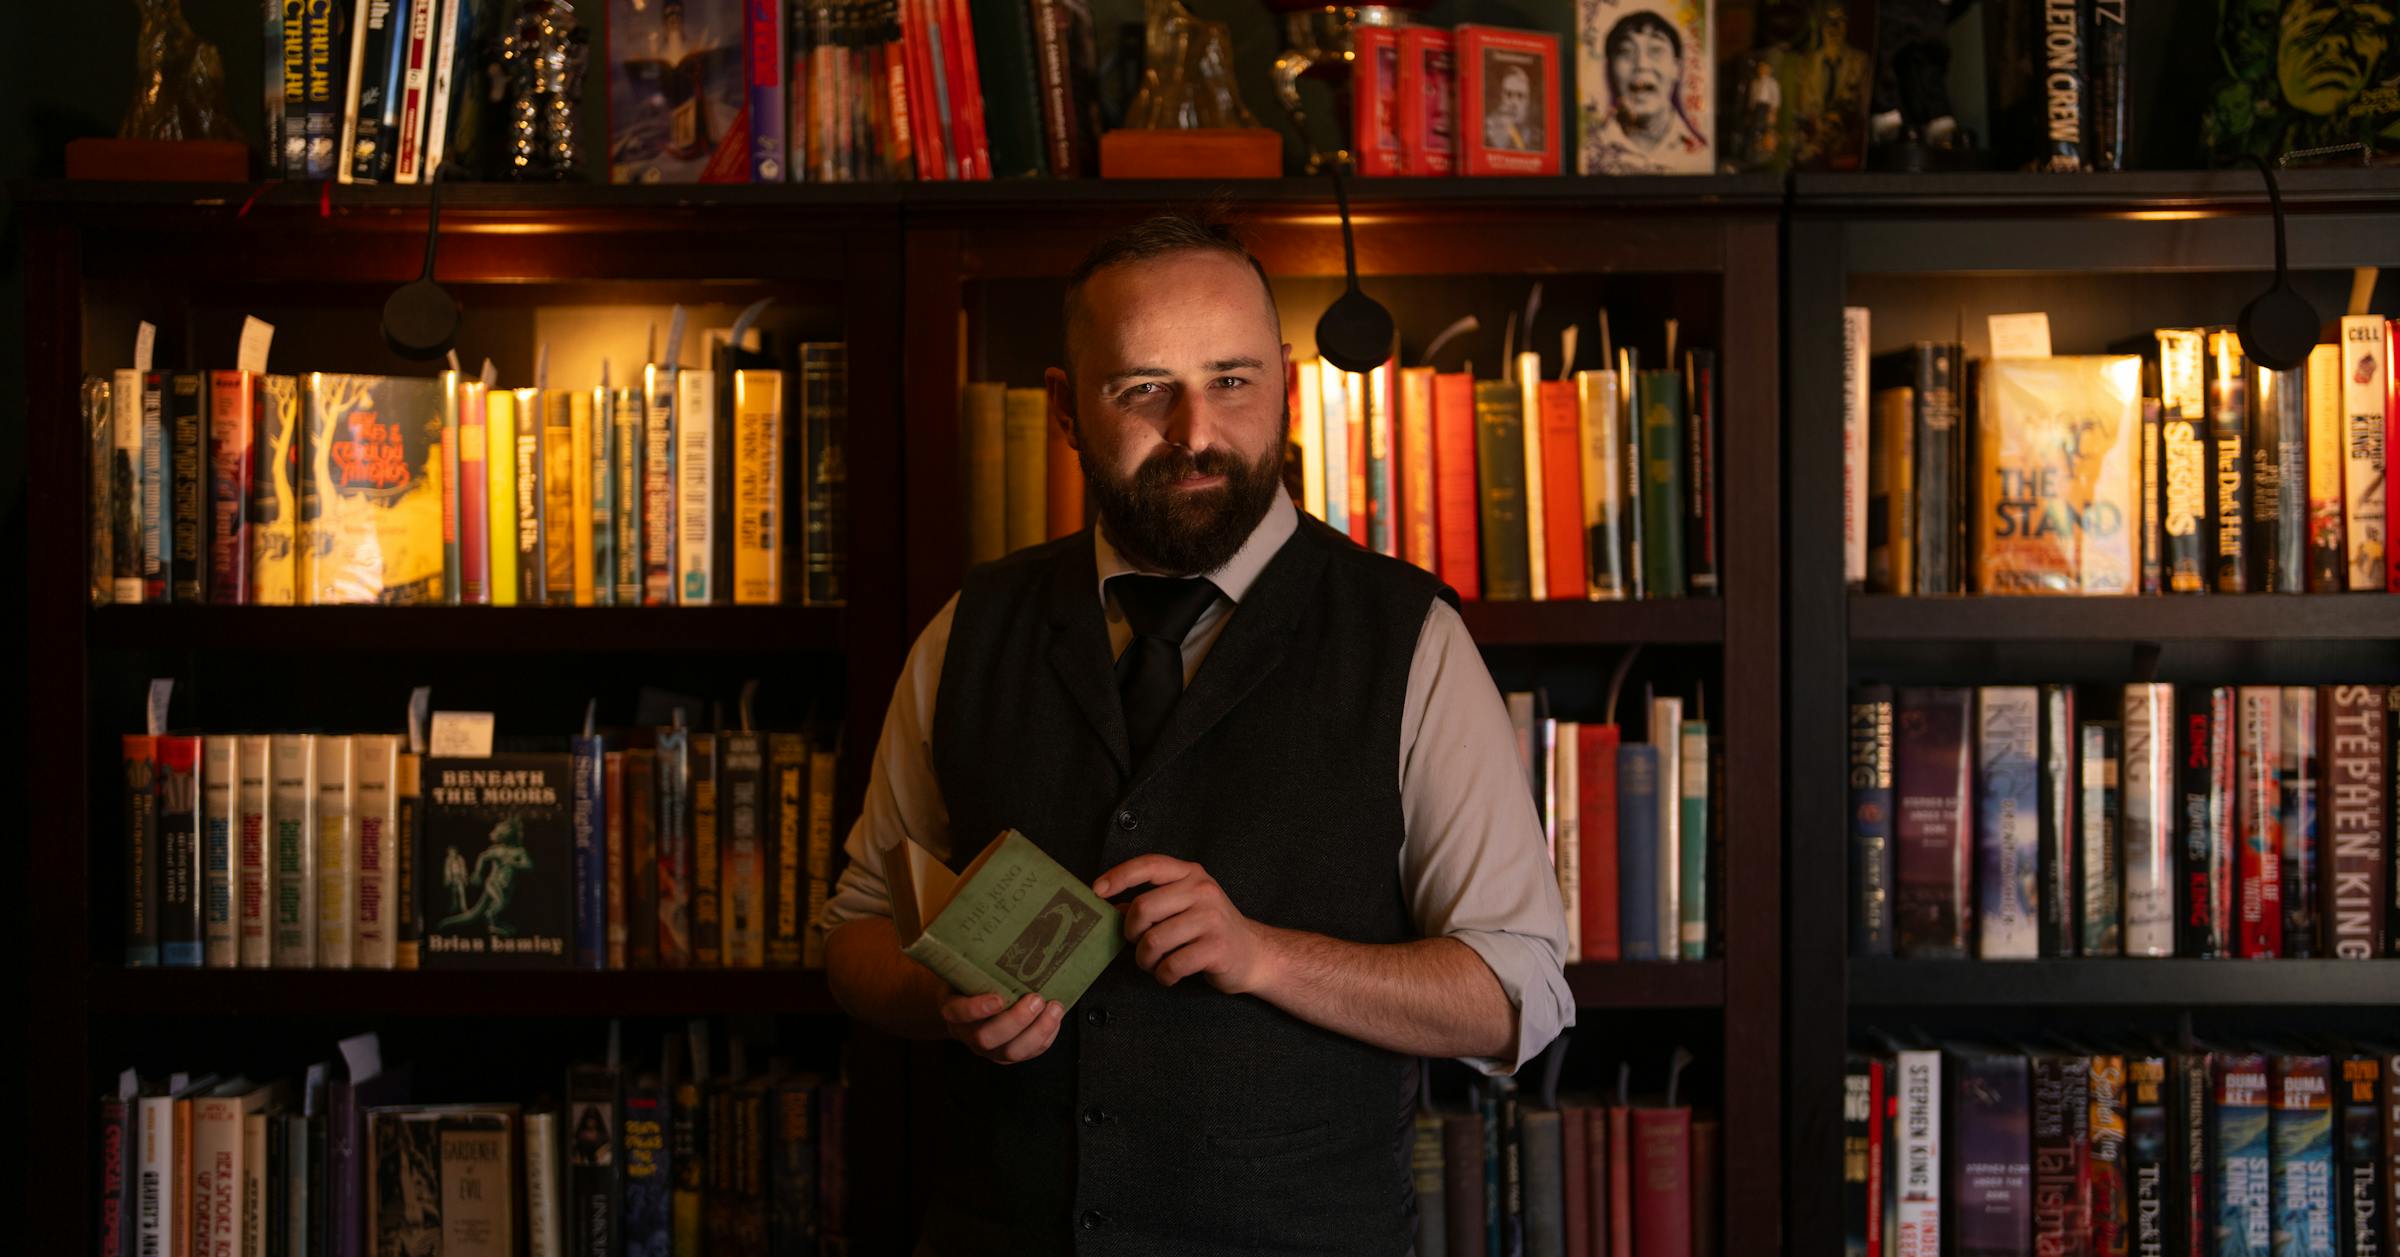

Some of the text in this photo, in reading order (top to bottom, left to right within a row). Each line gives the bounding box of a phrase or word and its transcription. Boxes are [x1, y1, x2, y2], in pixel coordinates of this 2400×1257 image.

[2046, 73, 2079, 143] CREW
[2349, 328, 2381, 341] CELL
[176, 415, 198, 442] WHO
[2350, 414, 2369, 460] KING
[1996, 466, 2059, 498] THE
[2163, 420, 2197, 537] SEASONS
[2218, 433, 2241, 558] The Dark Half
[517, 518, 538, 553] File
[1995, 501, 2122, 540] STAND
[1849, 702, 1877, 789] KING
[1877, 701, 1894, 790] STEPHEN
[1985, 702, 2016, 800] KING
[2126, 694, 2151, 783] KING
[2189, 713, 2208, 769] KING
[431, 785, 557, 806] THE MOORS
[440, 769, 546, 787] BENEATH
[209, 817, 228, 871] Selected
[243, 812, 263, 867] Selected
[360, 816, 382, 871] Selected
[2335, 684, 2372, 960] STEPHEN KING
[243, 871, 263, 918] Letters
[279, 819, 301, 925] Selected Letters
[2262, 853, 2279, 903] END OF
[209, 876, 228, 924] Letters
[360, 875, 382, 923] Letters
[959, 864, 1023, 933] THE KING
[971, 870, 1039, 945] YELLOW
[2189, 870, 2209, 928] KING
[2243, 876, 2261, 923] WATCH
[428, 933, 486, 954] Brian
[2225, 1072, 2268, 1091] DUMA
[2225, 1090, 2255, 1107] KEY
[2283, 1075, 2327, 1094] DUMA
[2283, 1093, 2313, 1110] KEY
[1909, 1064, 1930, 1186] STEPHEN KING
[2089, 1066, 2127, 1162] Stephen King
[196, 1171, 212, 1191] UP
[216, 1151, 233, 1181] HER
[2226, 1156, 2249, 1207] KING
[2286, 1160, 2308, 1211] KING
[143, 1171, 160, 1229] GRAVITY'S
[216, 1184, 233, 1234] SMOKE
[2138, 1162, 2160, 1242] The Dark
[2250, 1156, 2269, 1249] STEPHEN
[2307, 1160, 2329, 1251] STEPHEN
[2352, 1162, 2376, 1242] The Dark
